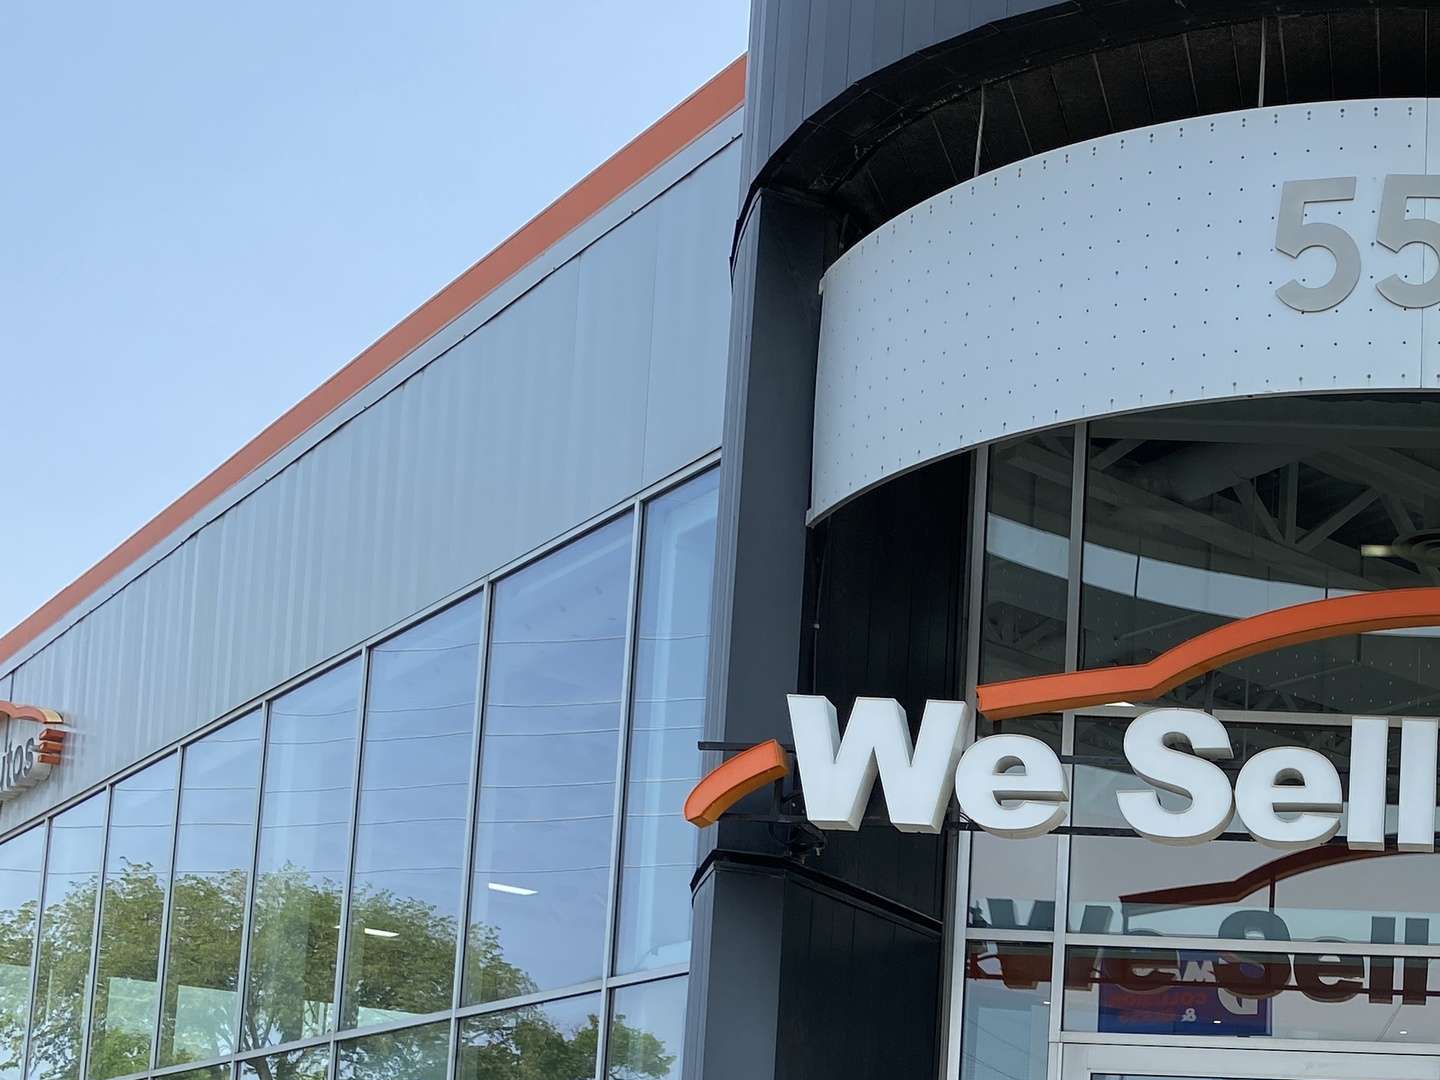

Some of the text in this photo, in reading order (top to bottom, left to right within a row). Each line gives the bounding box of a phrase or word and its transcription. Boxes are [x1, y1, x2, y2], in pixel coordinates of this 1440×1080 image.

[0, 737, 35, 792] tos
[786, 693, 1070, 840] We
[1116, 707, 1439, 853] Sell
